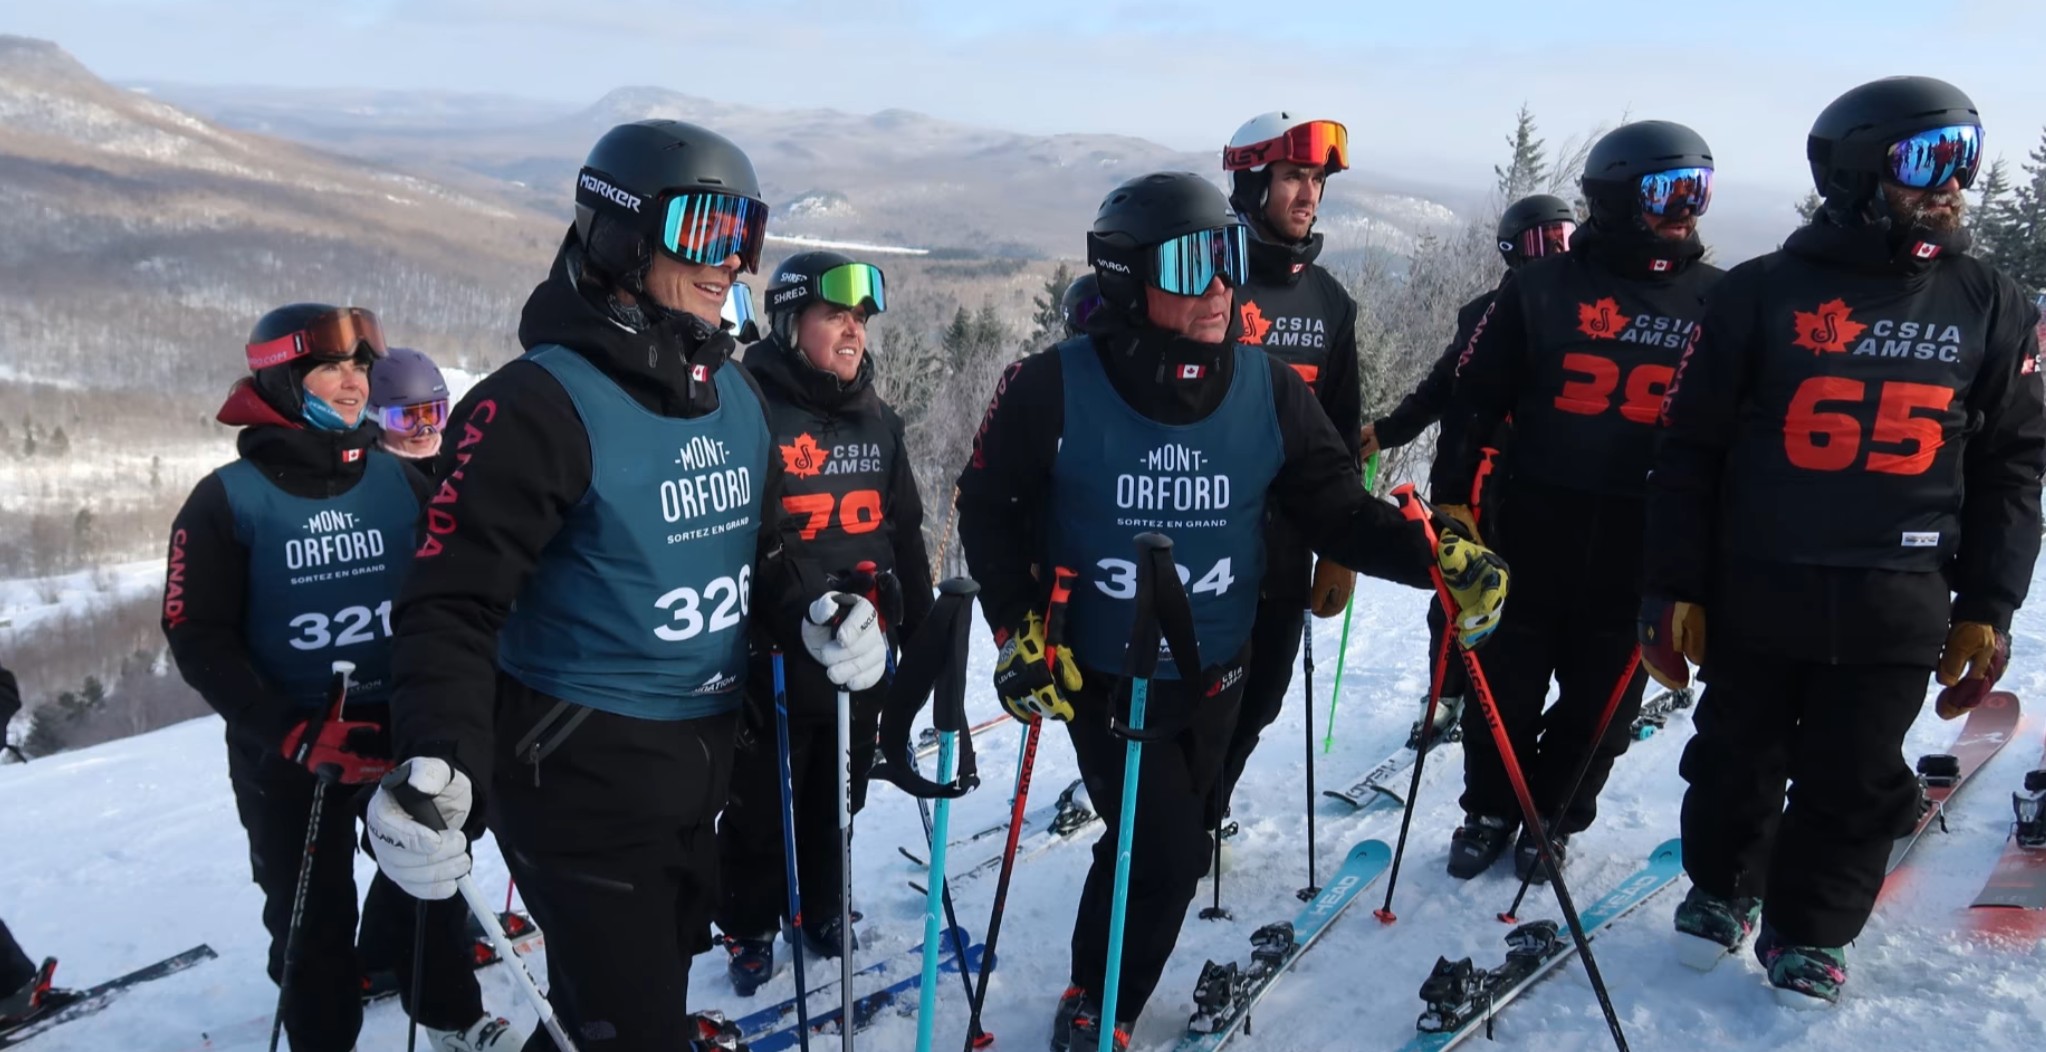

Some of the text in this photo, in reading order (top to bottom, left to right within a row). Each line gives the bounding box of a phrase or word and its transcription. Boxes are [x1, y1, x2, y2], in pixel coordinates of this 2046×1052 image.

[580, 173, 642, 213] MARKER
[1097, 258, 1130, 274] VARGA
[1276, 317, 1325, 333] CSIA
[1872, 320, 1961, 343] CSIA
[1783, 376, 1955, 476] 65
[833, 443, 881, 459] CSIA
[660, 466, 751, 523] ORFORD
[1116, 474, 1230, 511] ORFORD
[667, 516, 750, 544] SORTEZ EN GRAND
[1117, 518, 1227, 528] SORTEZ EN GRAND
[285, 529, 385, 570] ORFORD
[290, 564, 386, 585] SORTEZ EN GRAND
[653, 563, 751, 641] 326
[288, 600, 393, 650] 321
[998, 670, 1018, 684] LEVEL
[1309, 875, 1360, 916] HEAD
[1588, 875, 1659, 916] HEAD
